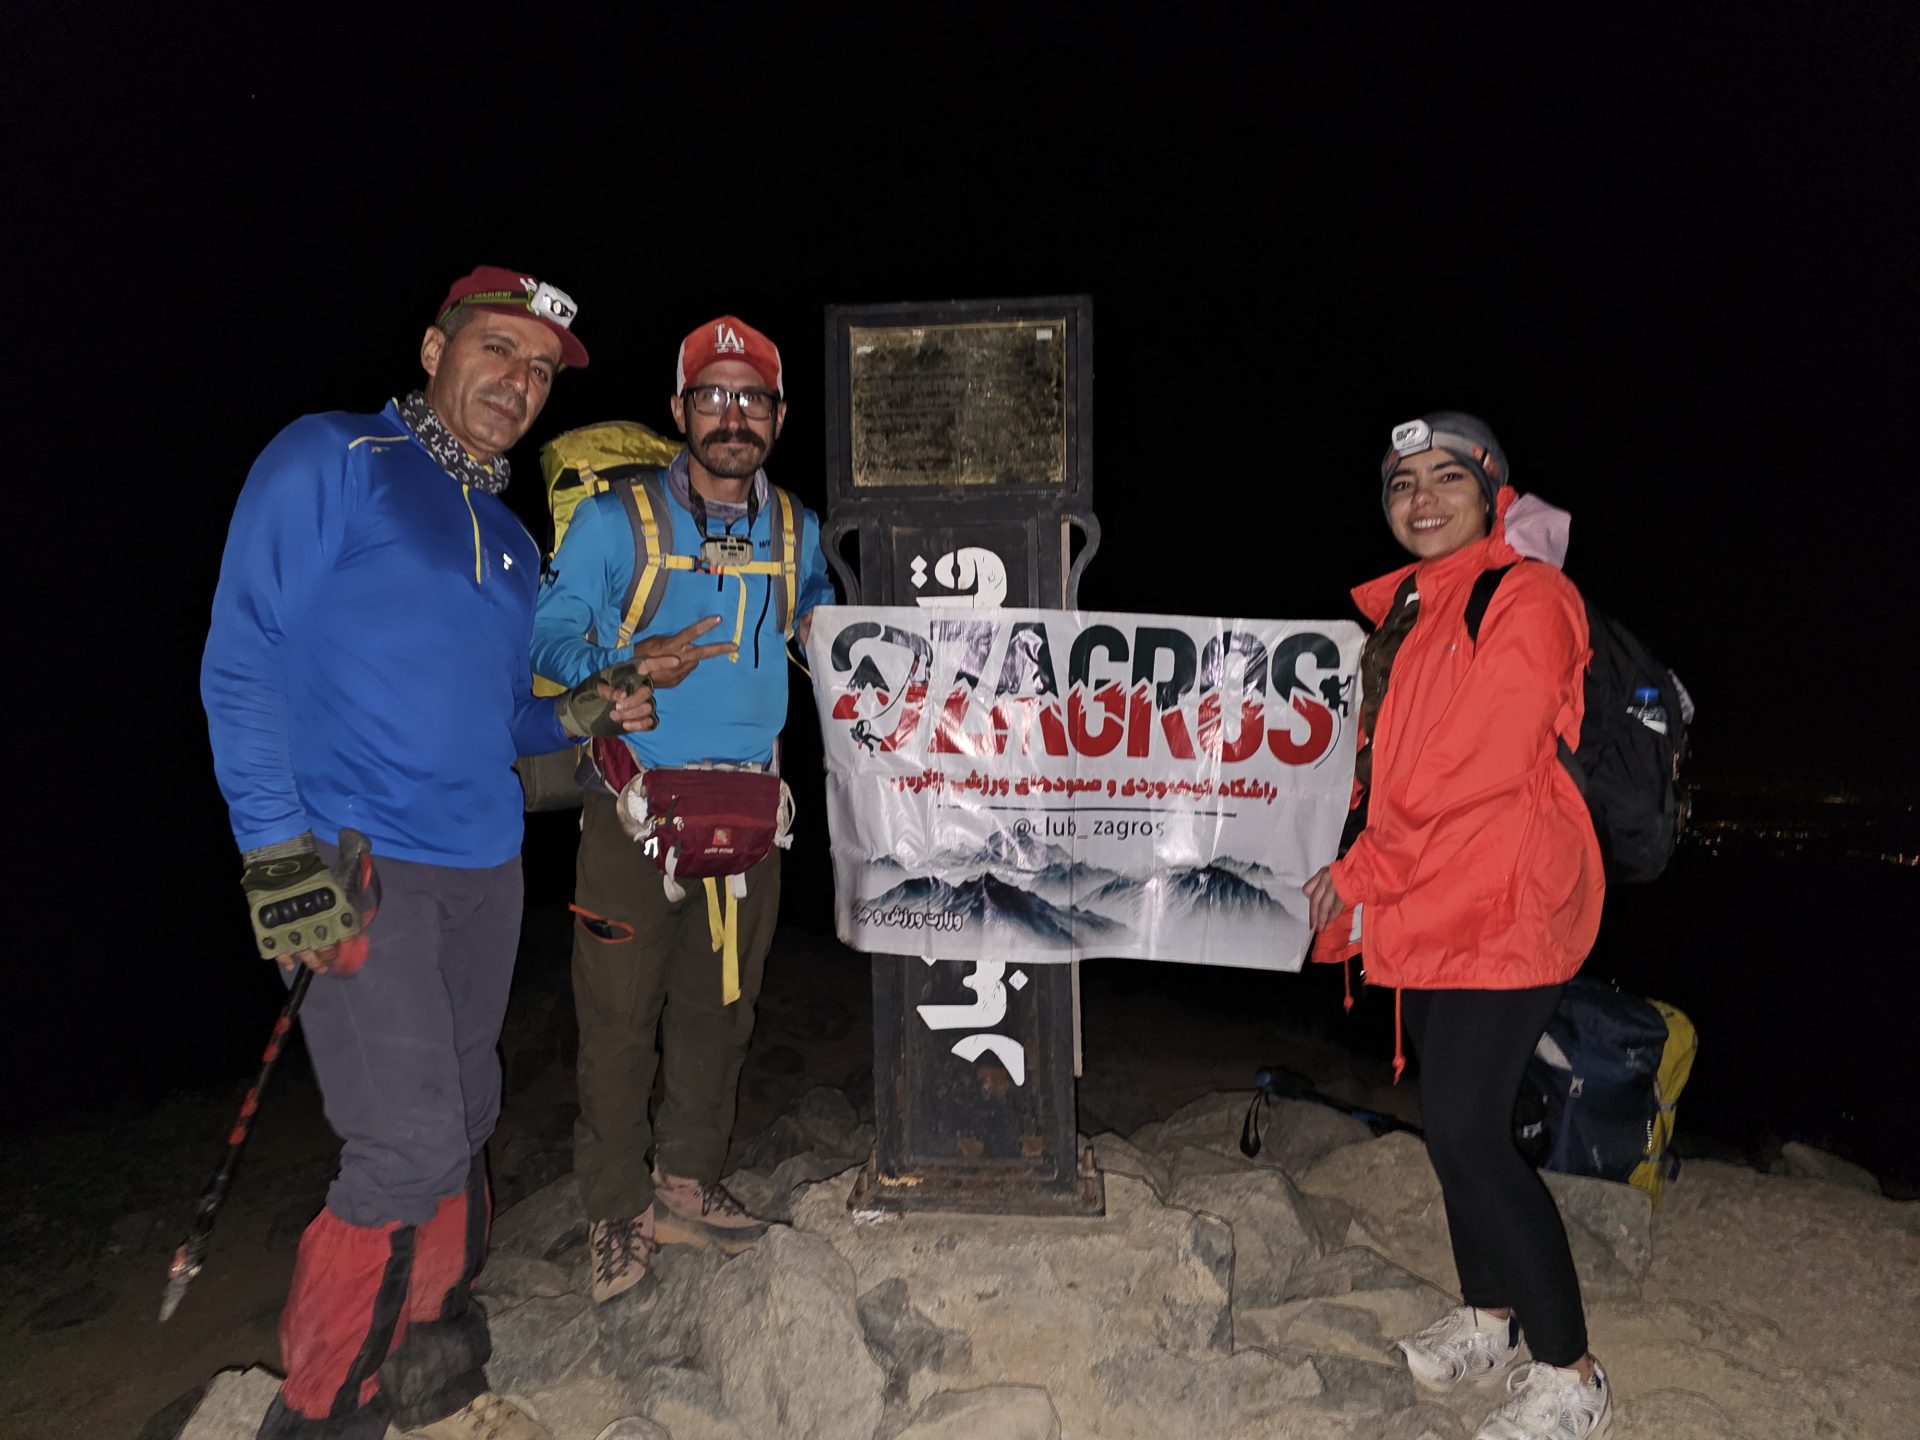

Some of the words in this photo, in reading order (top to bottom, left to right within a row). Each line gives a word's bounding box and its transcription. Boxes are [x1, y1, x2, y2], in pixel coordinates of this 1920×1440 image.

[714, 323, 745, 354] LA
[927, 619, 1341, 766] ZAGROS
[1107, 779, 1117, 798] و
